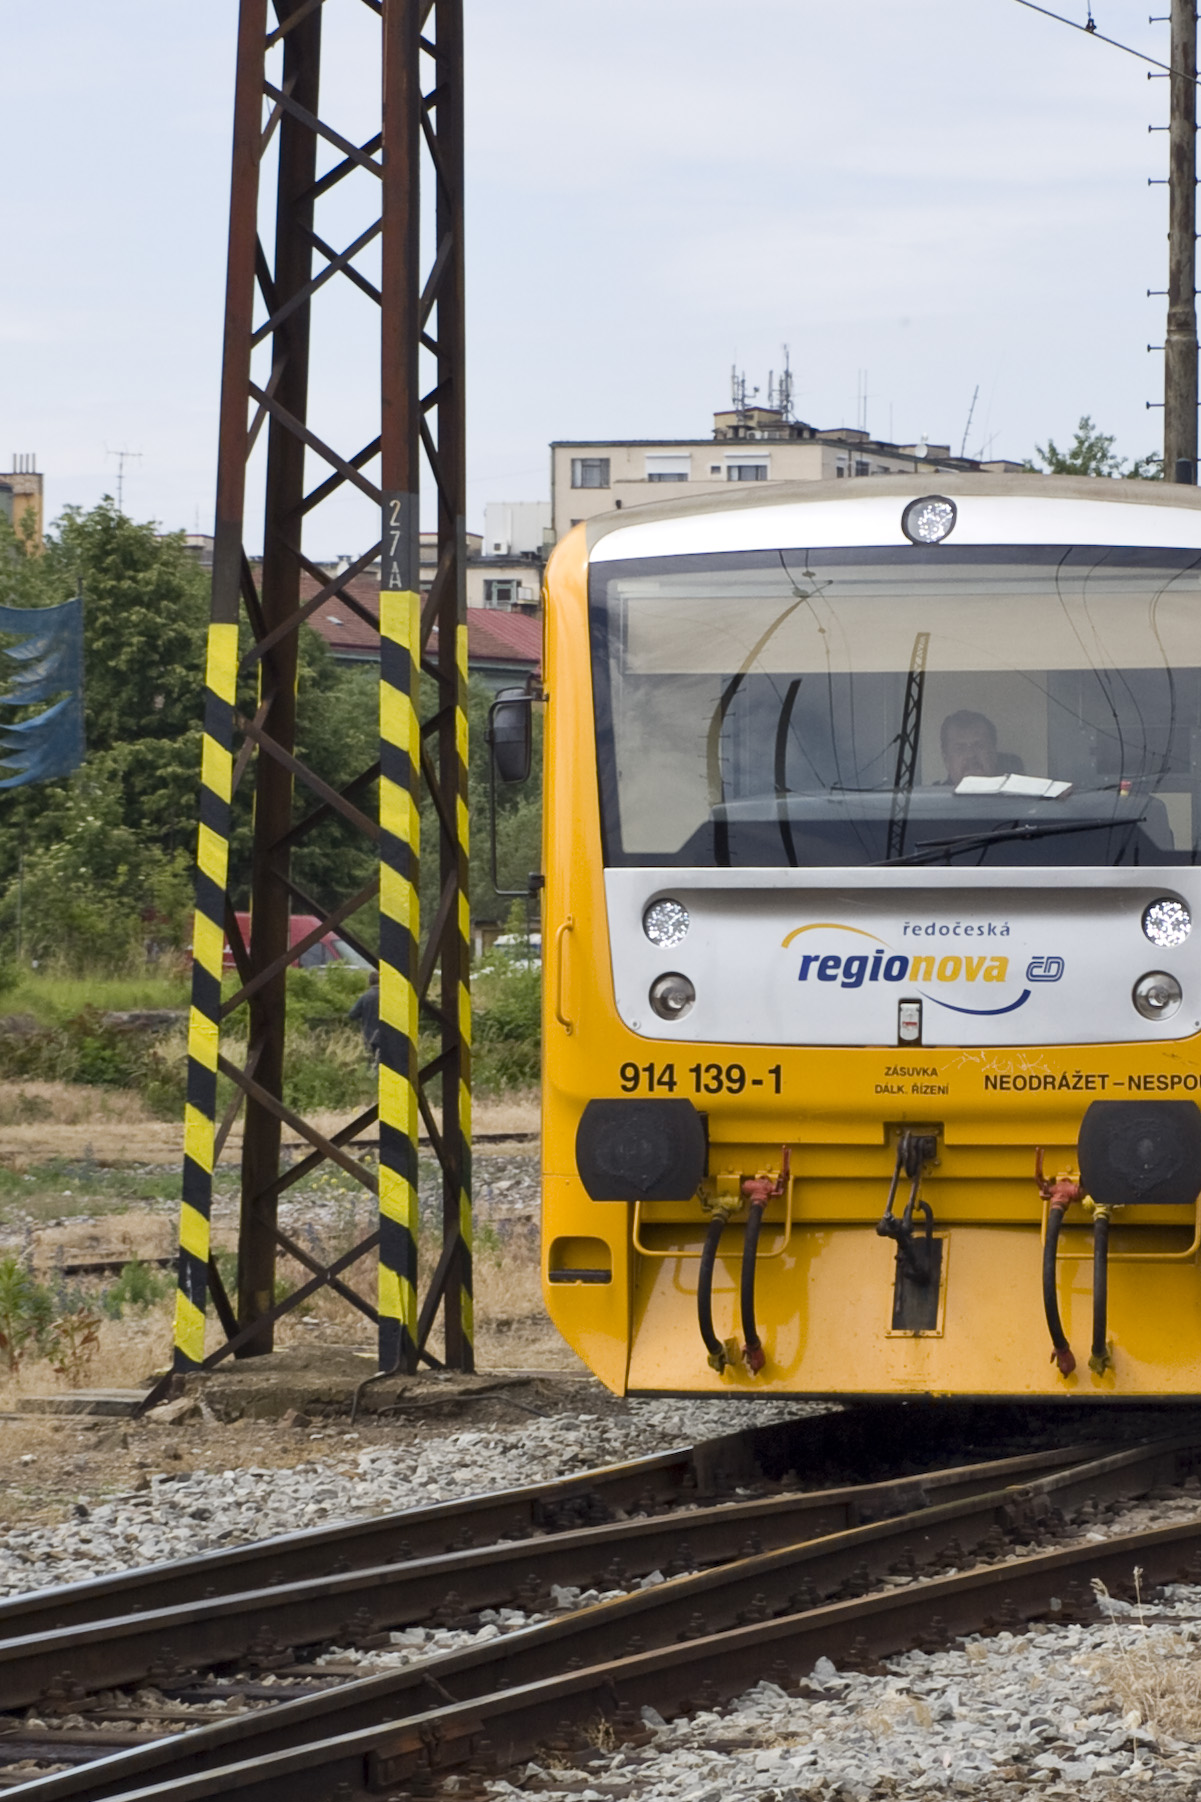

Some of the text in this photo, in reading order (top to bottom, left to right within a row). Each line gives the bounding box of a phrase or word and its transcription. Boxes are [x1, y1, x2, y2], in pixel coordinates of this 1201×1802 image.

[388, 499, 402, 588] 27A
[903, 921, 1010, 937] ředočeská
[798, 949, 1009, 988] regionova
[619, 1062, 677, 1093] 914
[884, 1064, 938, 1077] ZÁSUVKA
[984, 1070, 1110, 1091] NEODRÁŽET
[875, 1081, 949, 1096] DÁLK. ŘÍZENÍ
